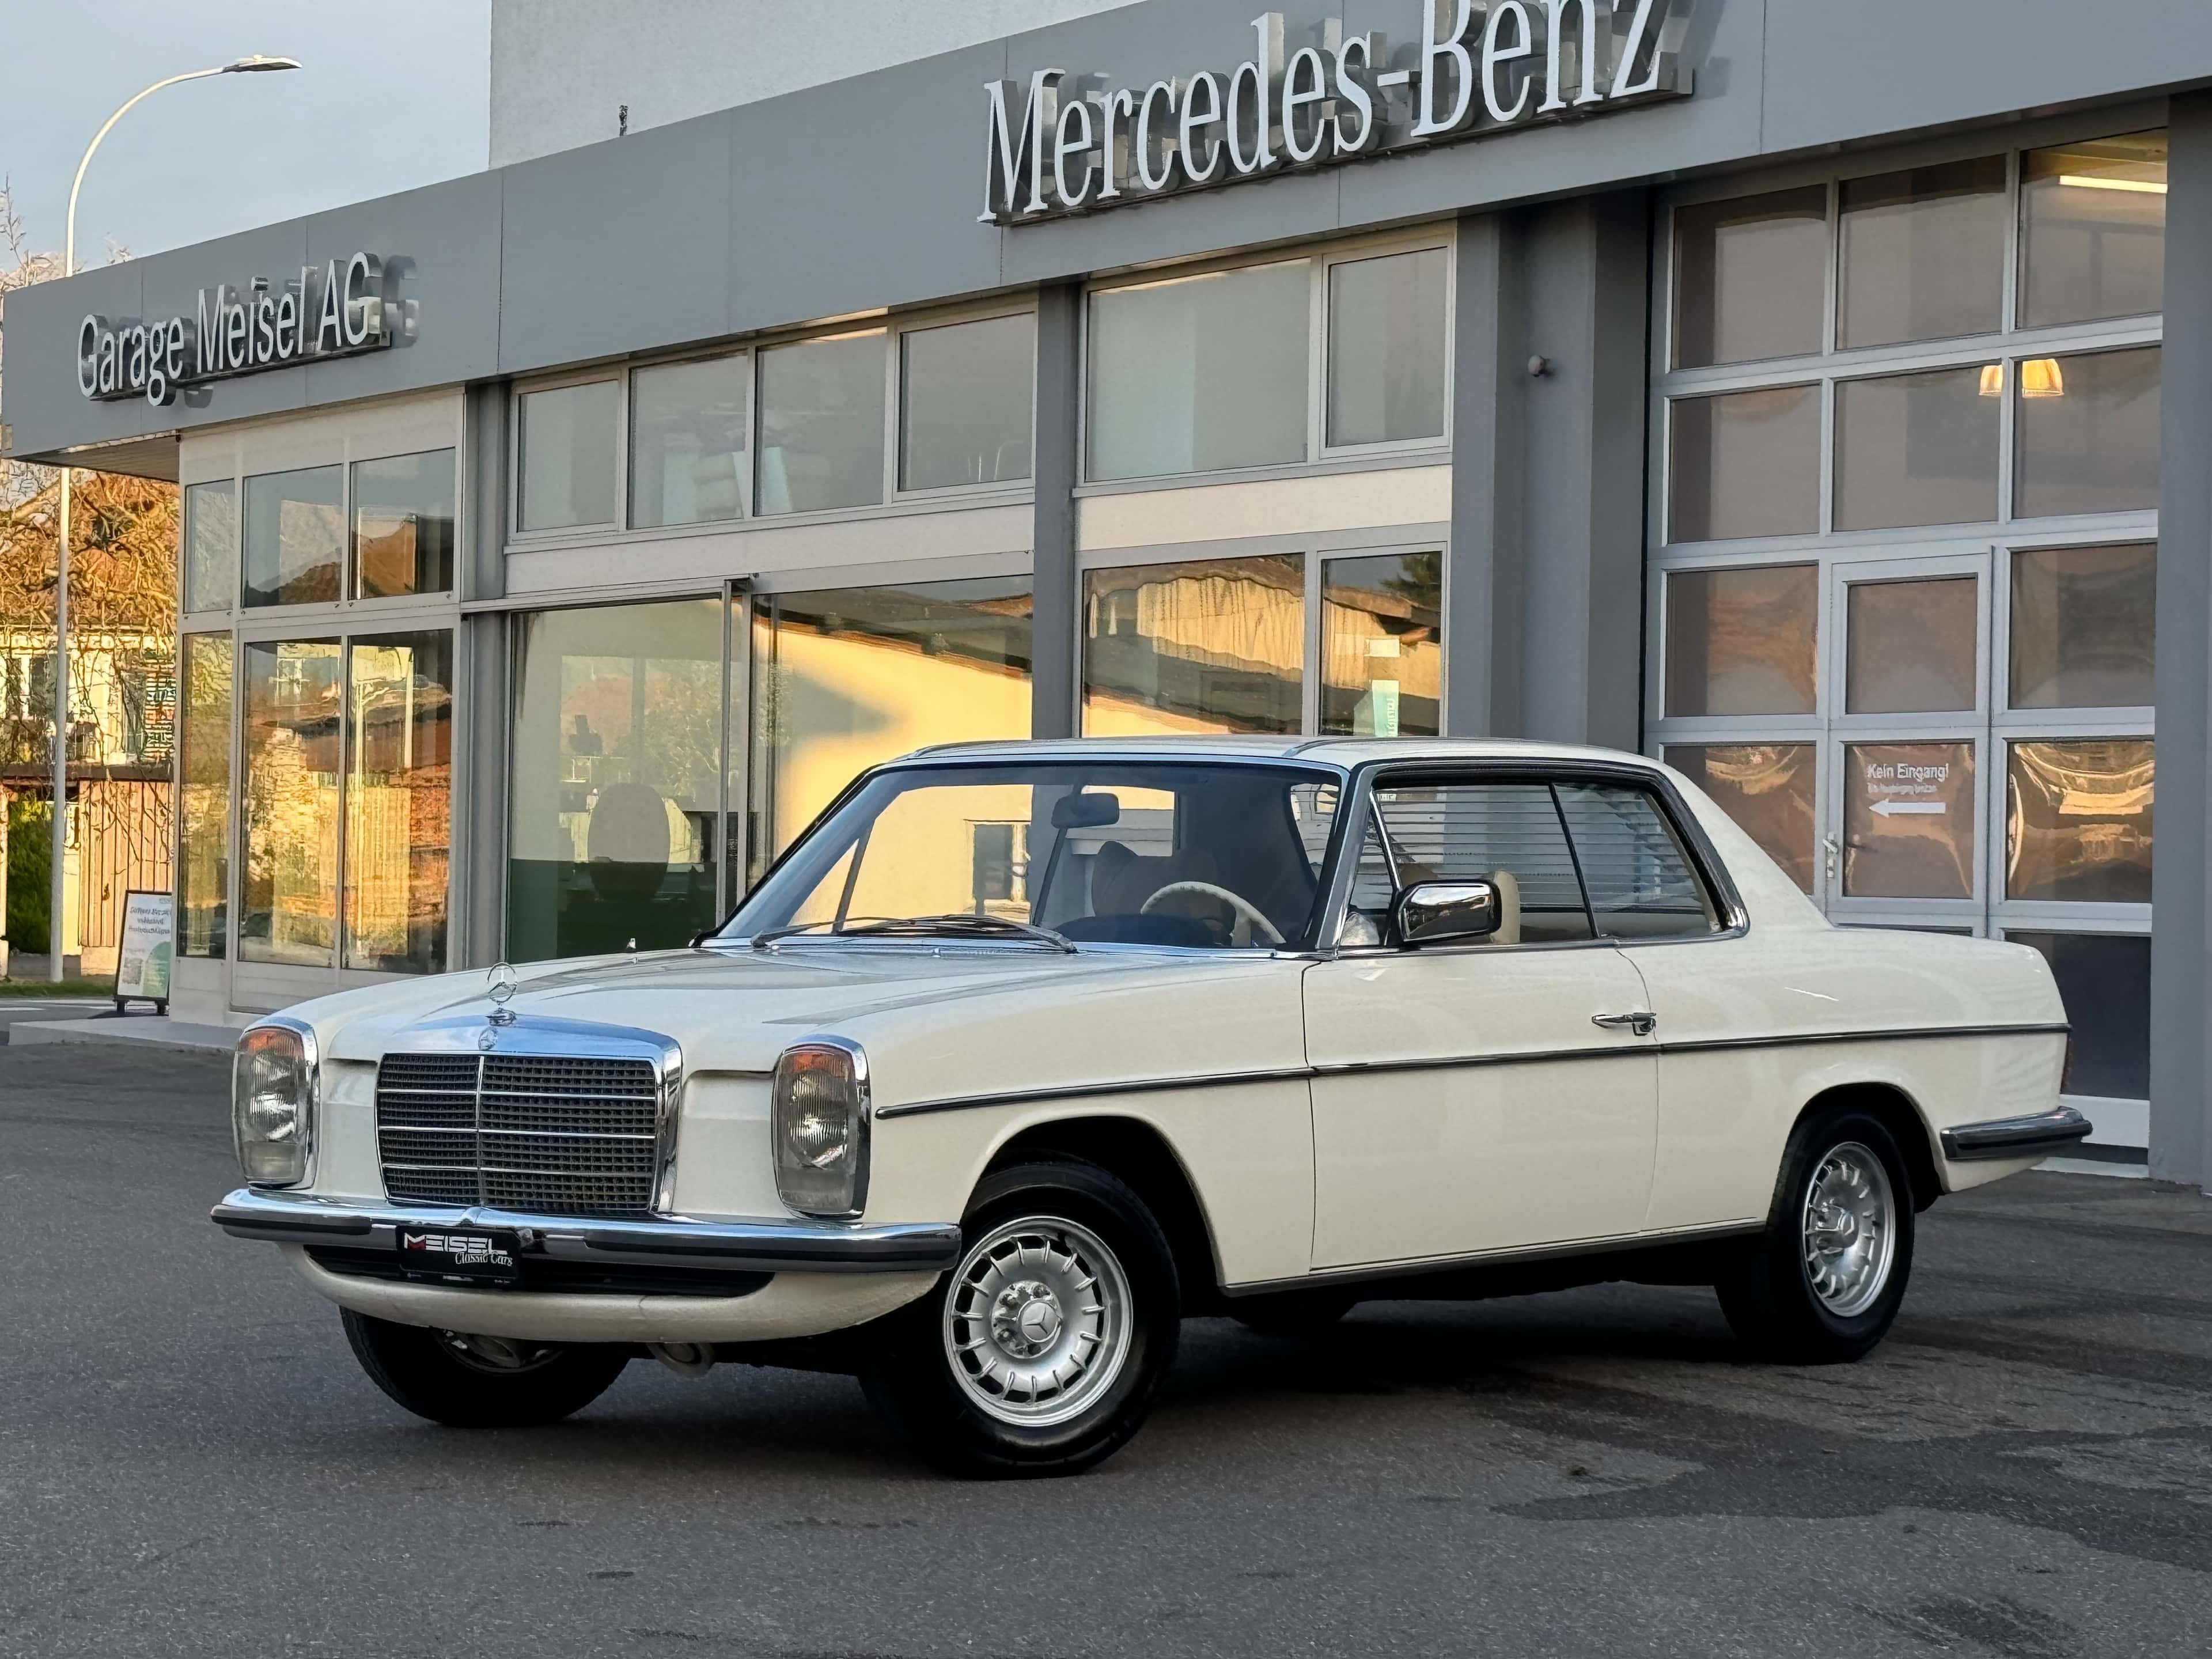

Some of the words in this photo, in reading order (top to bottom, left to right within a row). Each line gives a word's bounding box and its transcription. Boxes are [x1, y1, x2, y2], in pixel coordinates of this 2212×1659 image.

[976, 0, 1662, 224] Mercedes-Benz
[77, 314, 185, 406] Garage
[196, 266, 310, 374] Meisel
[316, 251, 379, 351] AG
[1867, 763, 1895, 779] Kein
[404, 1232, 508, 1255] MEISEL
[454, 1251, 488, 1265] Classic
[490, 1251, 513, 1267] Cars
